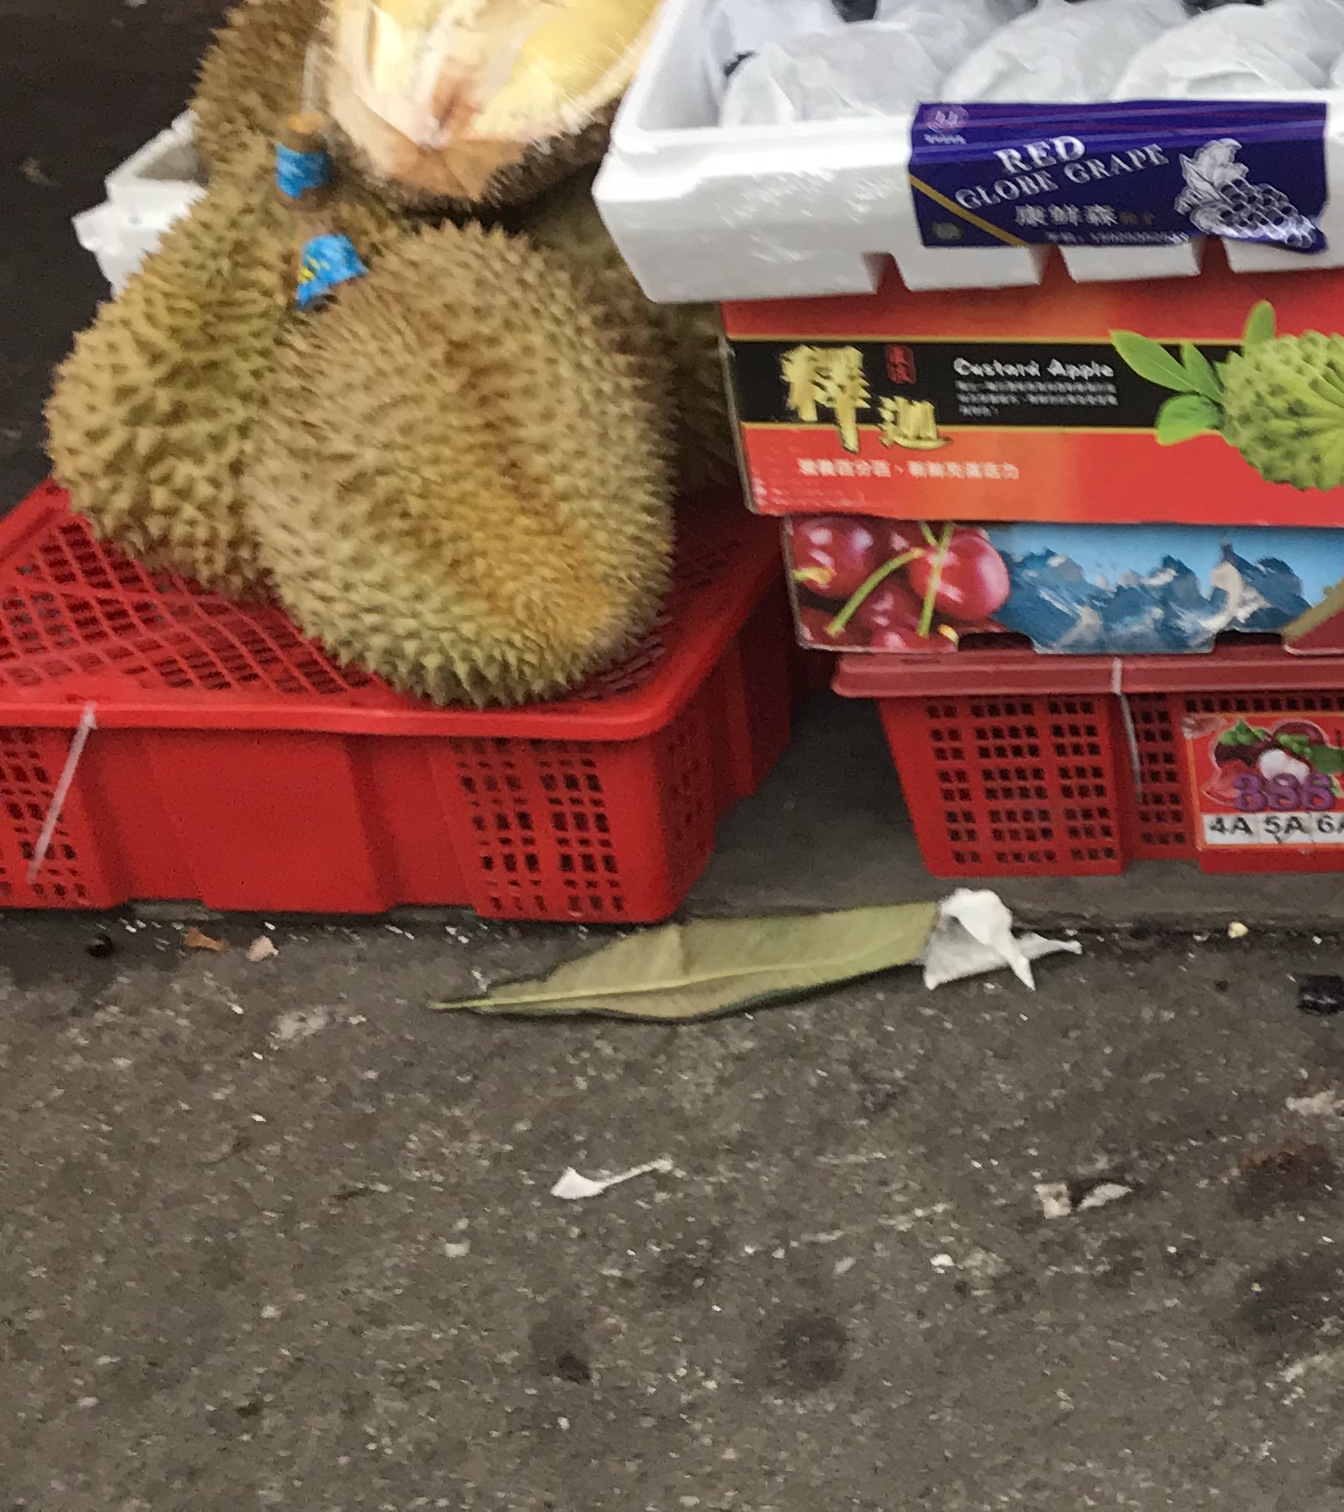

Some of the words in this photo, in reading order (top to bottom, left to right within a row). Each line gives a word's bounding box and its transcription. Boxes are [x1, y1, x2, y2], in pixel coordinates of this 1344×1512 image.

[993, 135, 1086, 176] RED
[955, 171, 1060, 211] GLOBE
[1063, 143, 1170, 186] GRAPE
[953, 358, 1041, 378] Custard
[1047, 358, 1115, 381] Apple
[1209, 815, 1254, 837] 4A
